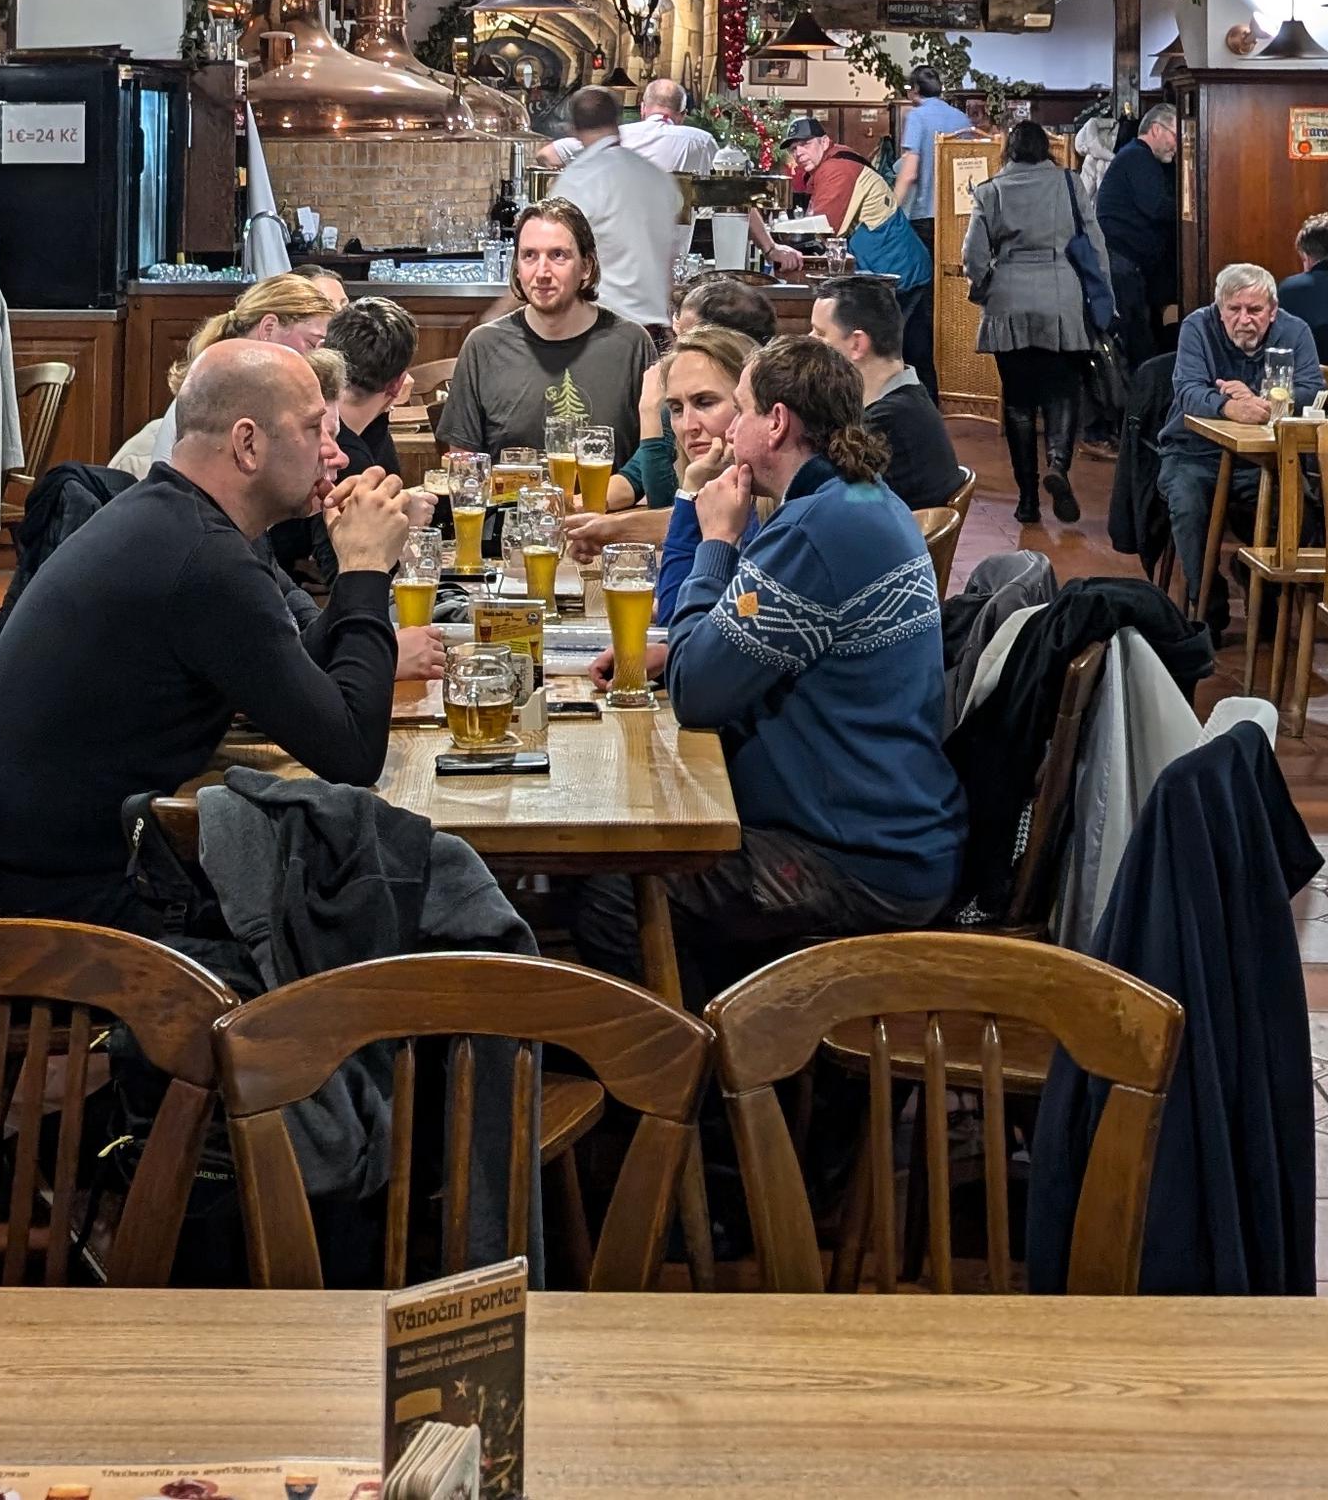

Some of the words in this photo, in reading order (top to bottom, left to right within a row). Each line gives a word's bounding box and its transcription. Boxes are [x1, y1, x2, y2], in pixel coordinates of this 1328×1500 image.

[7, 128, 55, 143] 1€=24
[60, 127, 78, 143] Kč
[393, 1296, 464, 1333] Vánoční
[470, 1285, 522, 1319] porter
